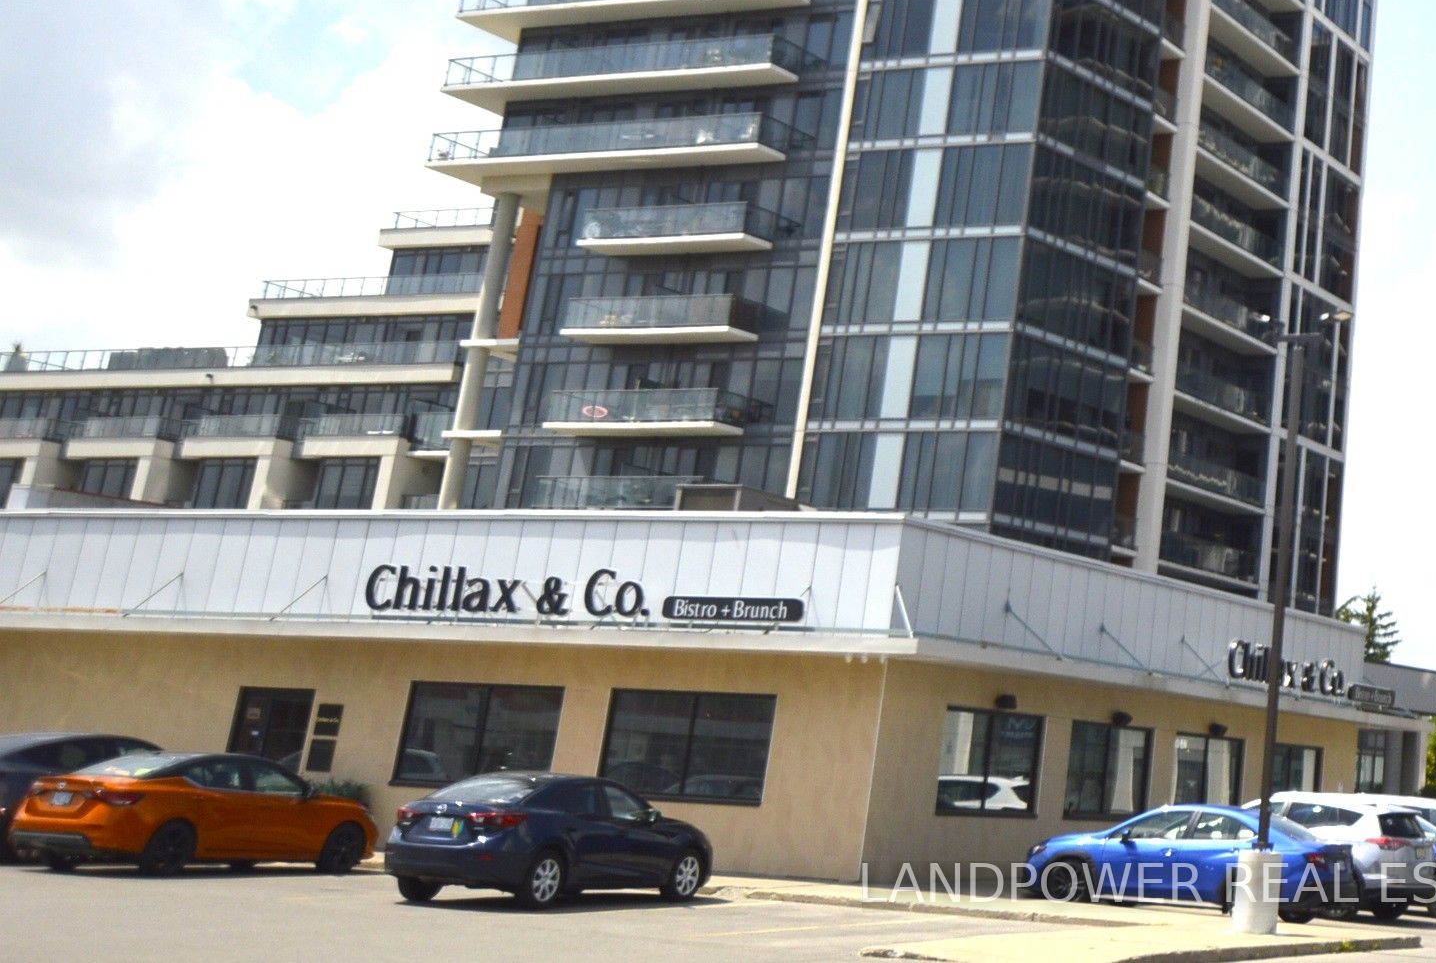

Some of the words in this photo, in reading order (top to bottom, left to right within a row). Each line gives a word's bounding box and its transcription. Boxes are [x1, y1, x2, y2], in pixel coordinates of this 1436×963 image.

[365, 564, 523, 614] Chillax
[536, 576, 570, 616] &
[584, 568, 651, 618] Co.
[674, 599, 717, 618] Bistro
[733, 600, 788, 619] Brunch
